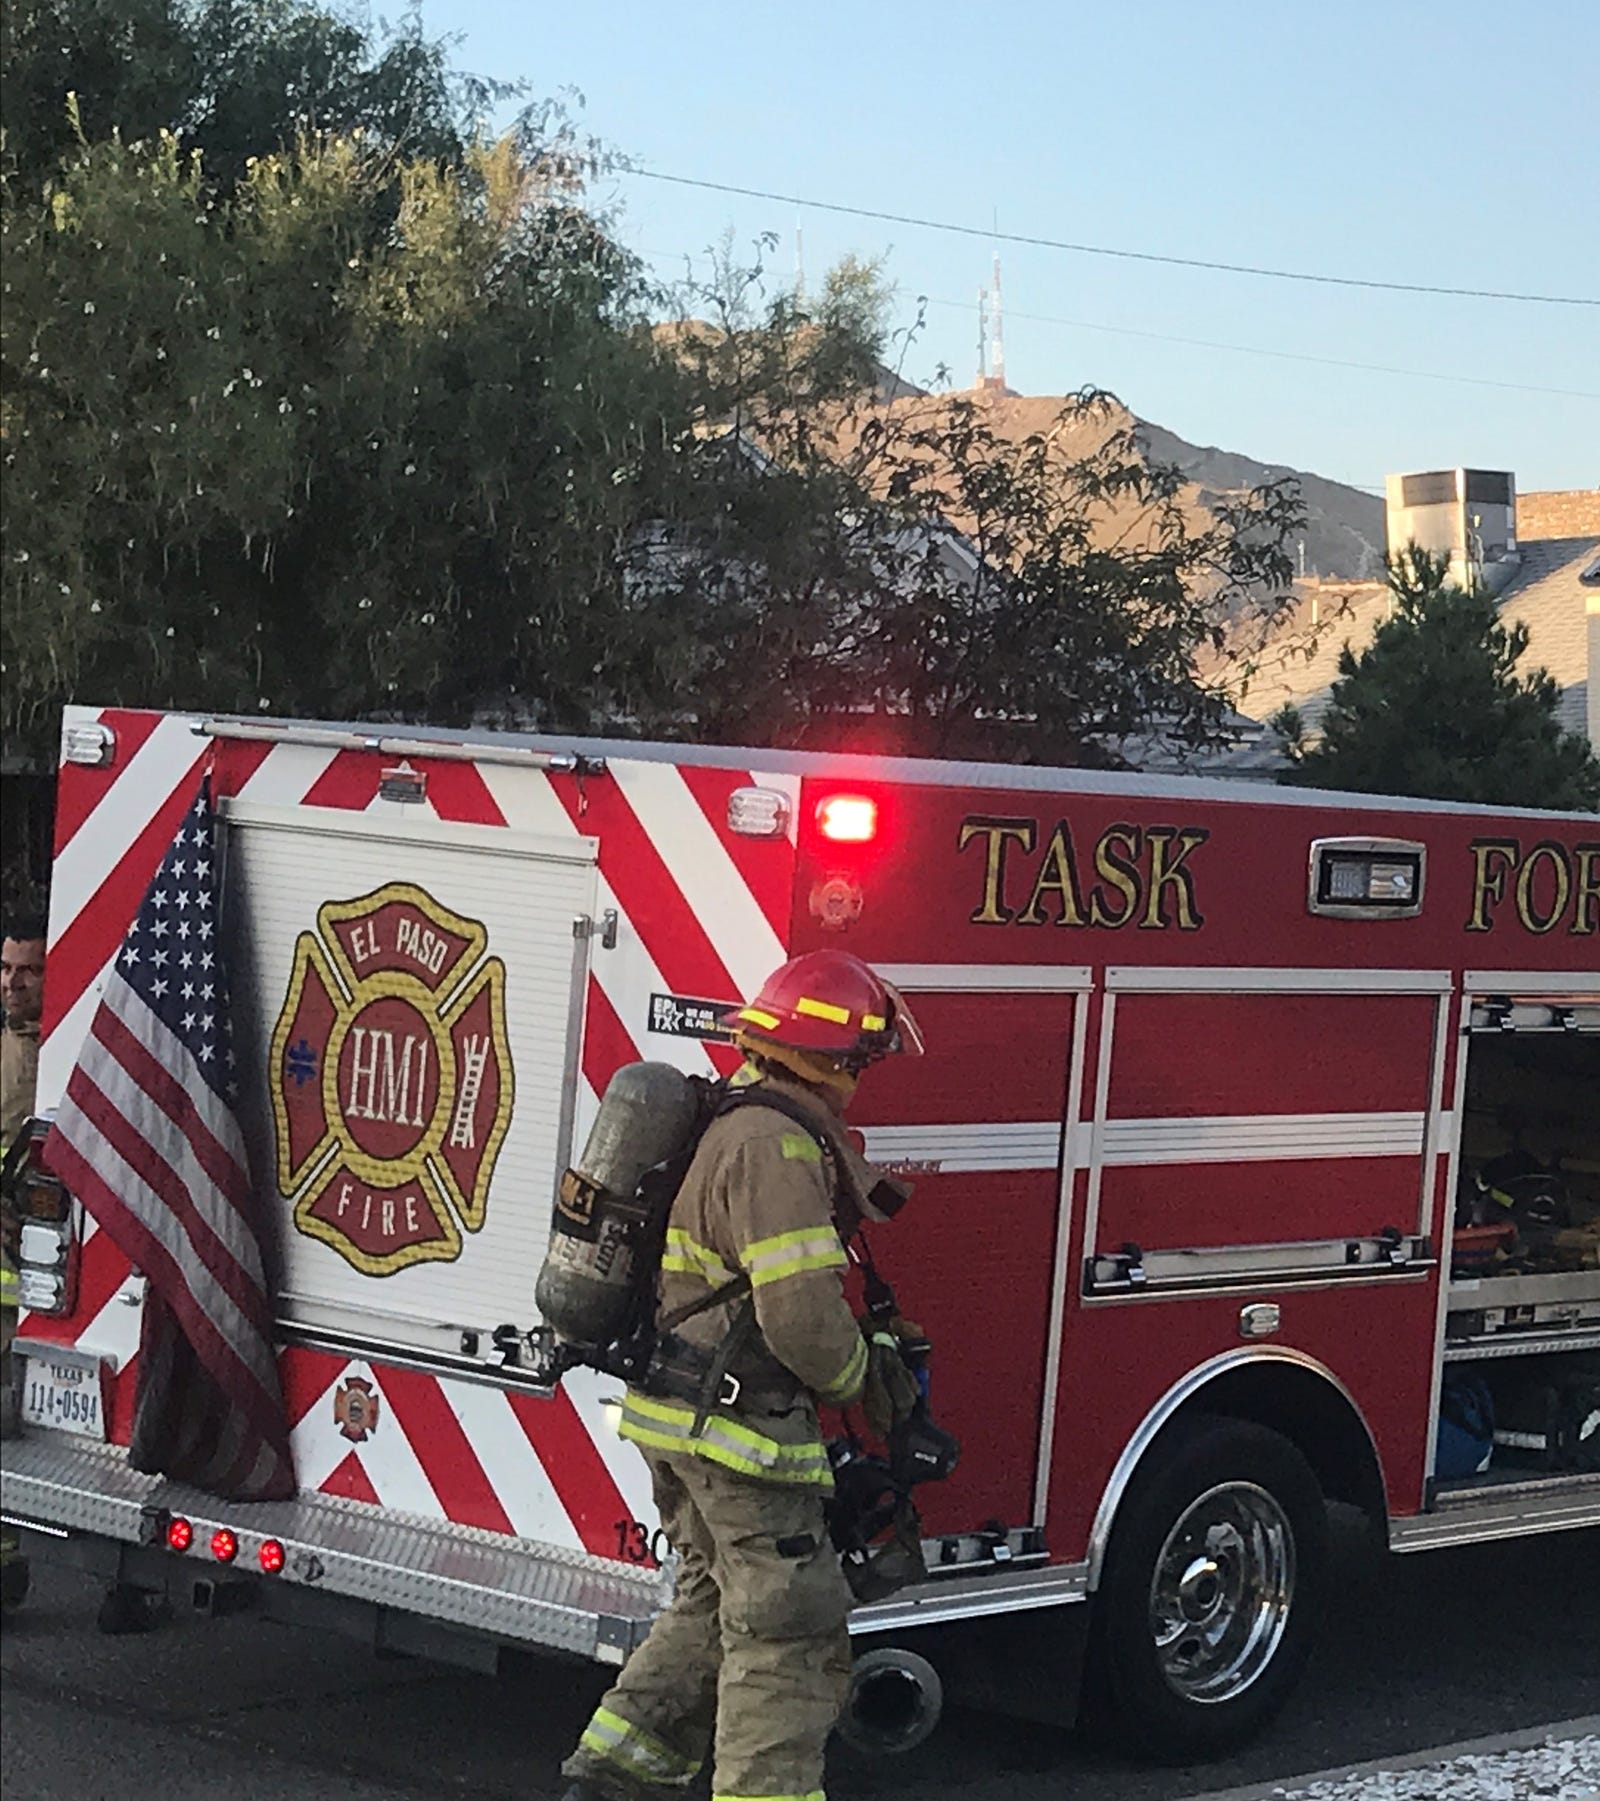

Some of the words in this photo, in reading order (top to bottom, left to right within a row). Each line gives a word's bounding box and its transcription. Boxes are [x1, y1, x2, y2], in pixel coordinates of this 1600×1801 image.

[957, 815, 1208, 929] TASK
[350, 920, 381, 963] EL
[396, 918, 448, 974] PASO
[345, 1028, 428, 1127] HM1
[337, 1183, 419, 1235] FIRE
[51, 1364, 83, 1384] TEXAS
[29, 1382, 97, 1424] 114-0594
